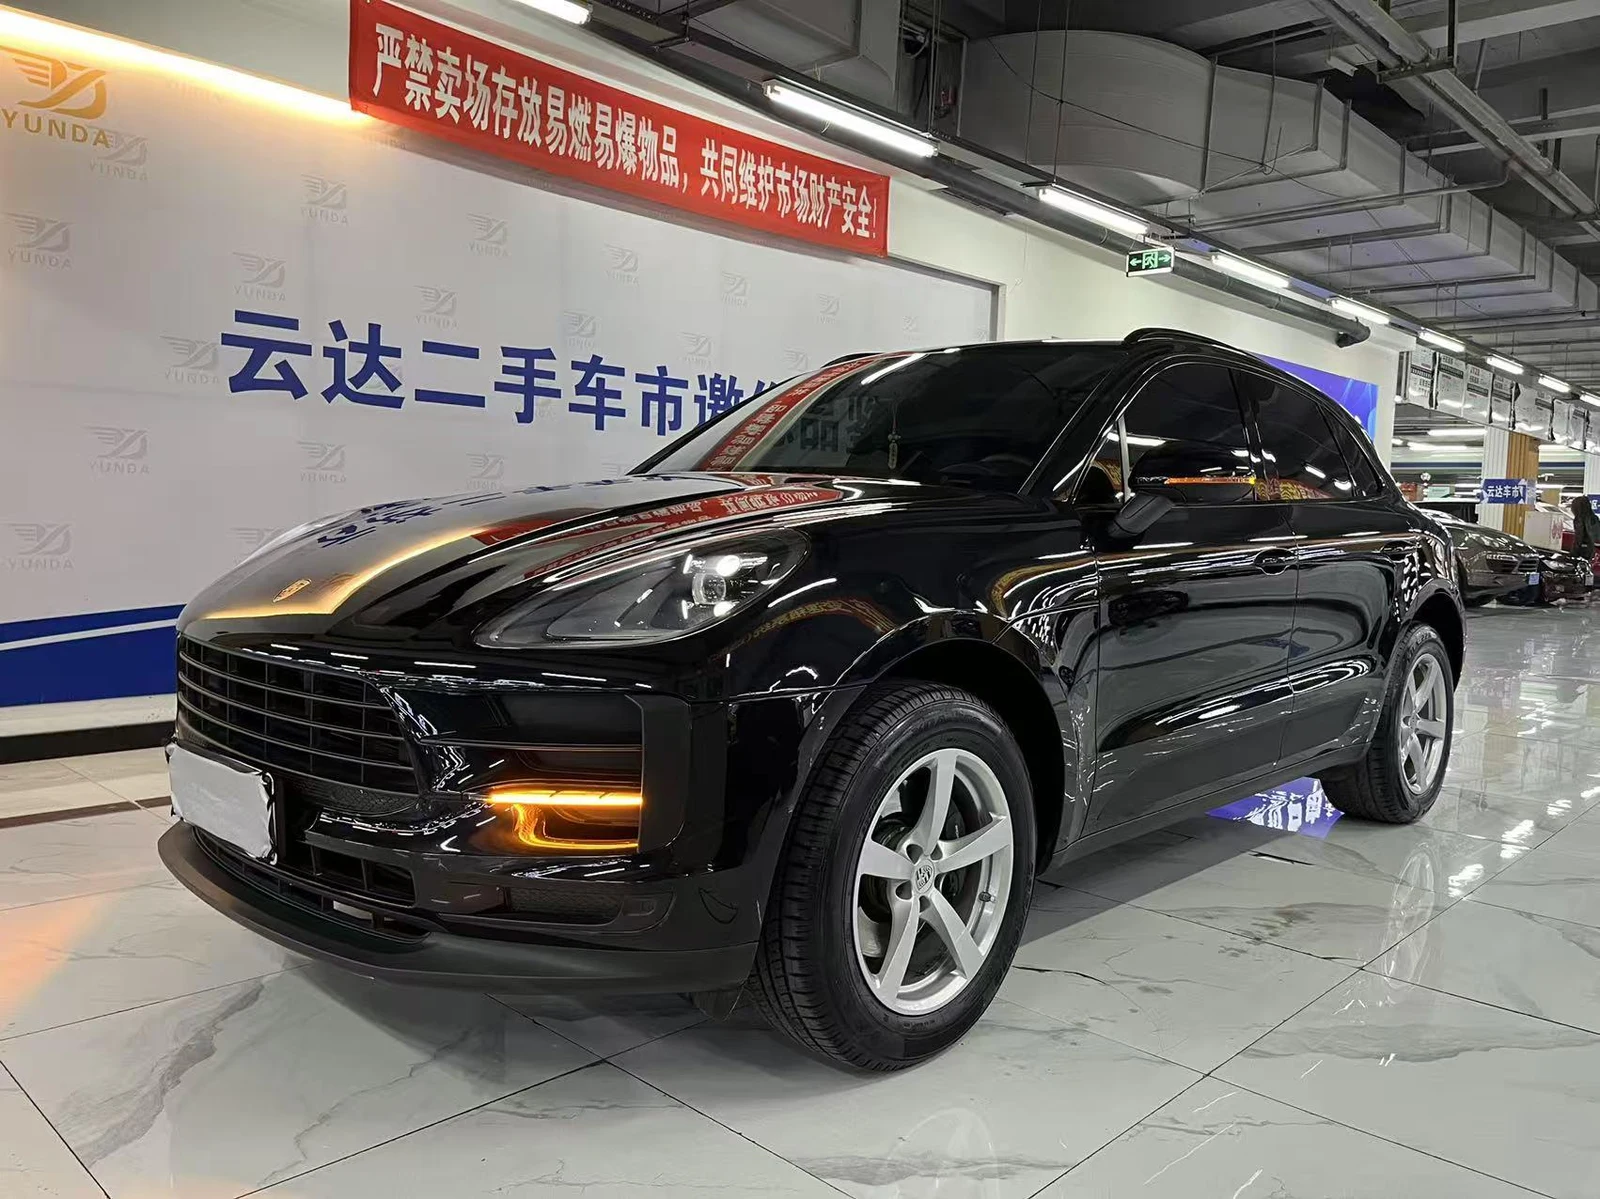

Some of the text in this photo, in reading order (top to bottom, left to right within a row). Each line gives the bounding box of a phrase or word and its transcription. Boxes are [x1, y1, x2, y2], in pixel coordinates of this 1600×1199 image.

[0, 107, 110, 149] YUNDA
[8, 248, 73, 271] YUNDA
[220, 308, 778, 437] 云达二手车市邀
[89, 458, 150, 475] YUNDA
[1487, 485, 1519, 499] 云达车市
[7, 556, 75, 572] YUNDA
